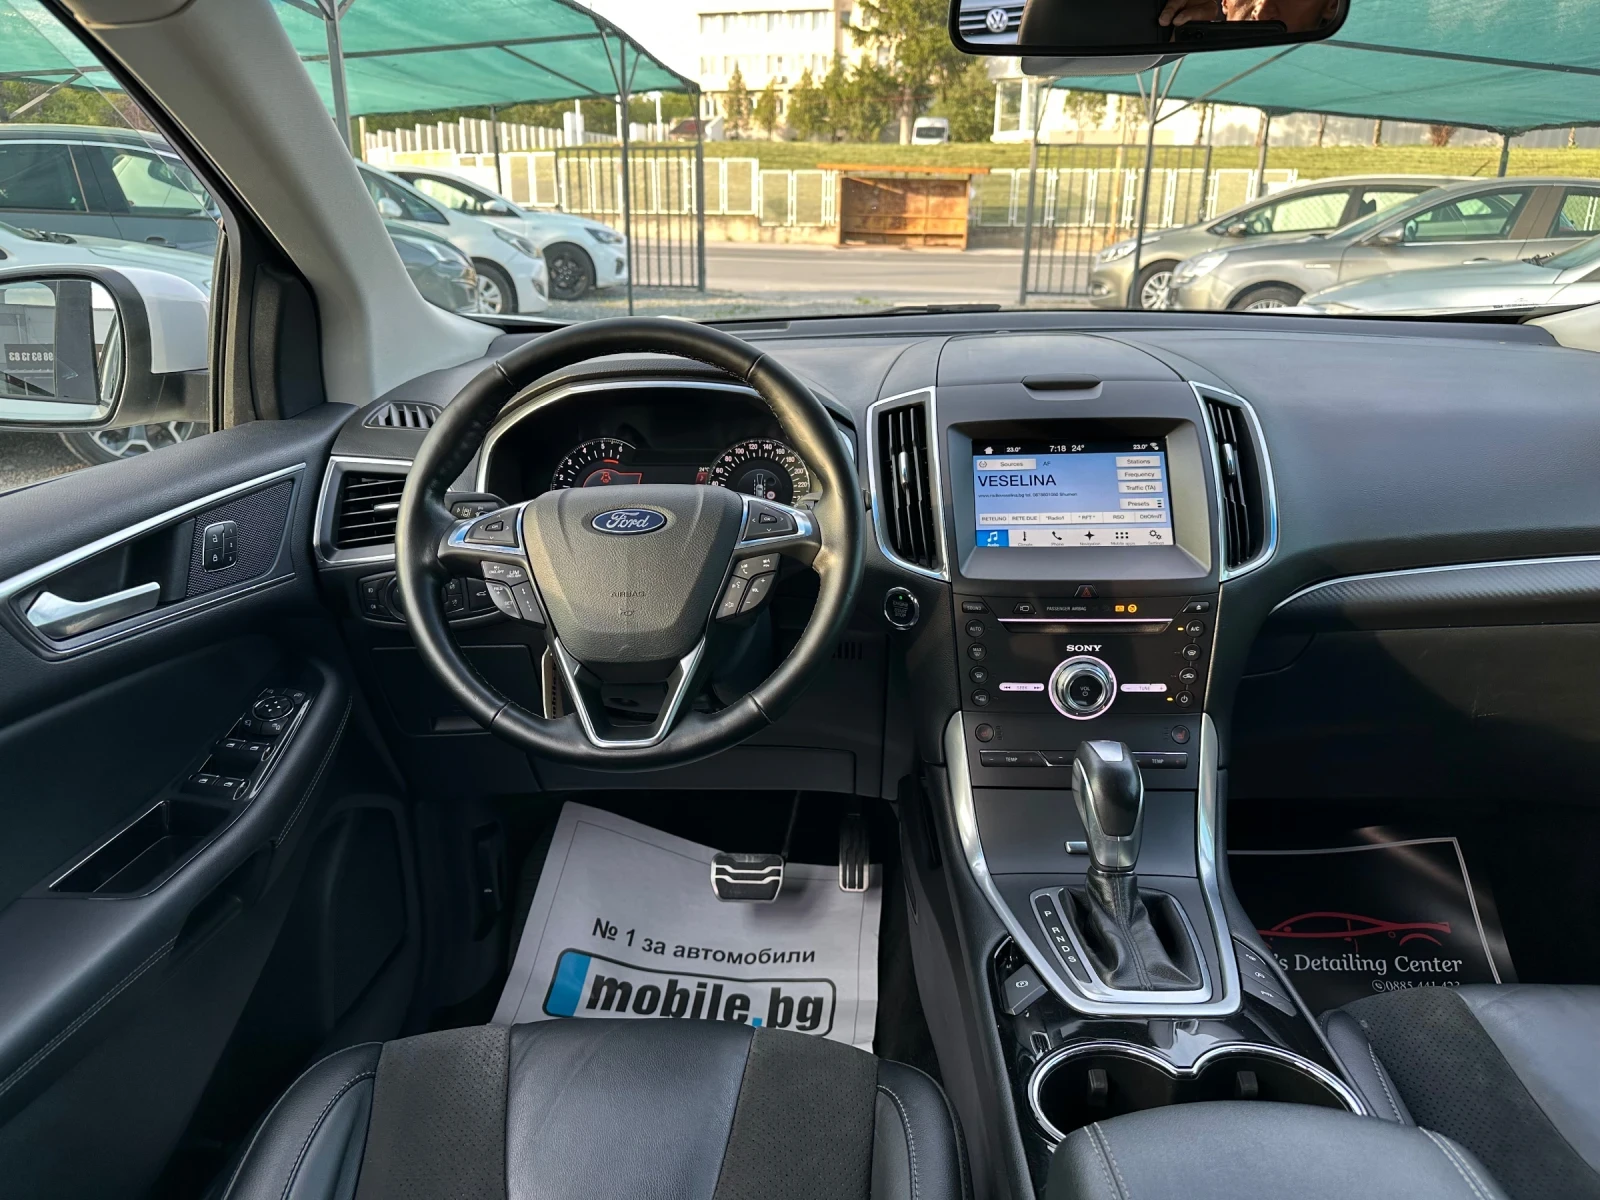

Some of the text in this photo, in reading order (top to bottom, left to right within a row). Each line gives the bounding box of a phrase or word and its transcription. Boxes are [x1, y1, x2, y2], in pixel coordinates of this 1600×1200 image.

[1071, 444, 1085, 452] 24°
[978, 474, 1056, 487] VESELINA
[605, 511, 649, 529] Ford
[1051, 926, 1060, 934] R
[626, 929, 636, 947] 1
[641, 938, 665, 955] за
[673, 945, 816, 965] автомобили
[1295, 953, 1387, 975] Detailing
[1394, 956, 1463, 973] Center
[585, 974, 824, 1030] mobile.bg
